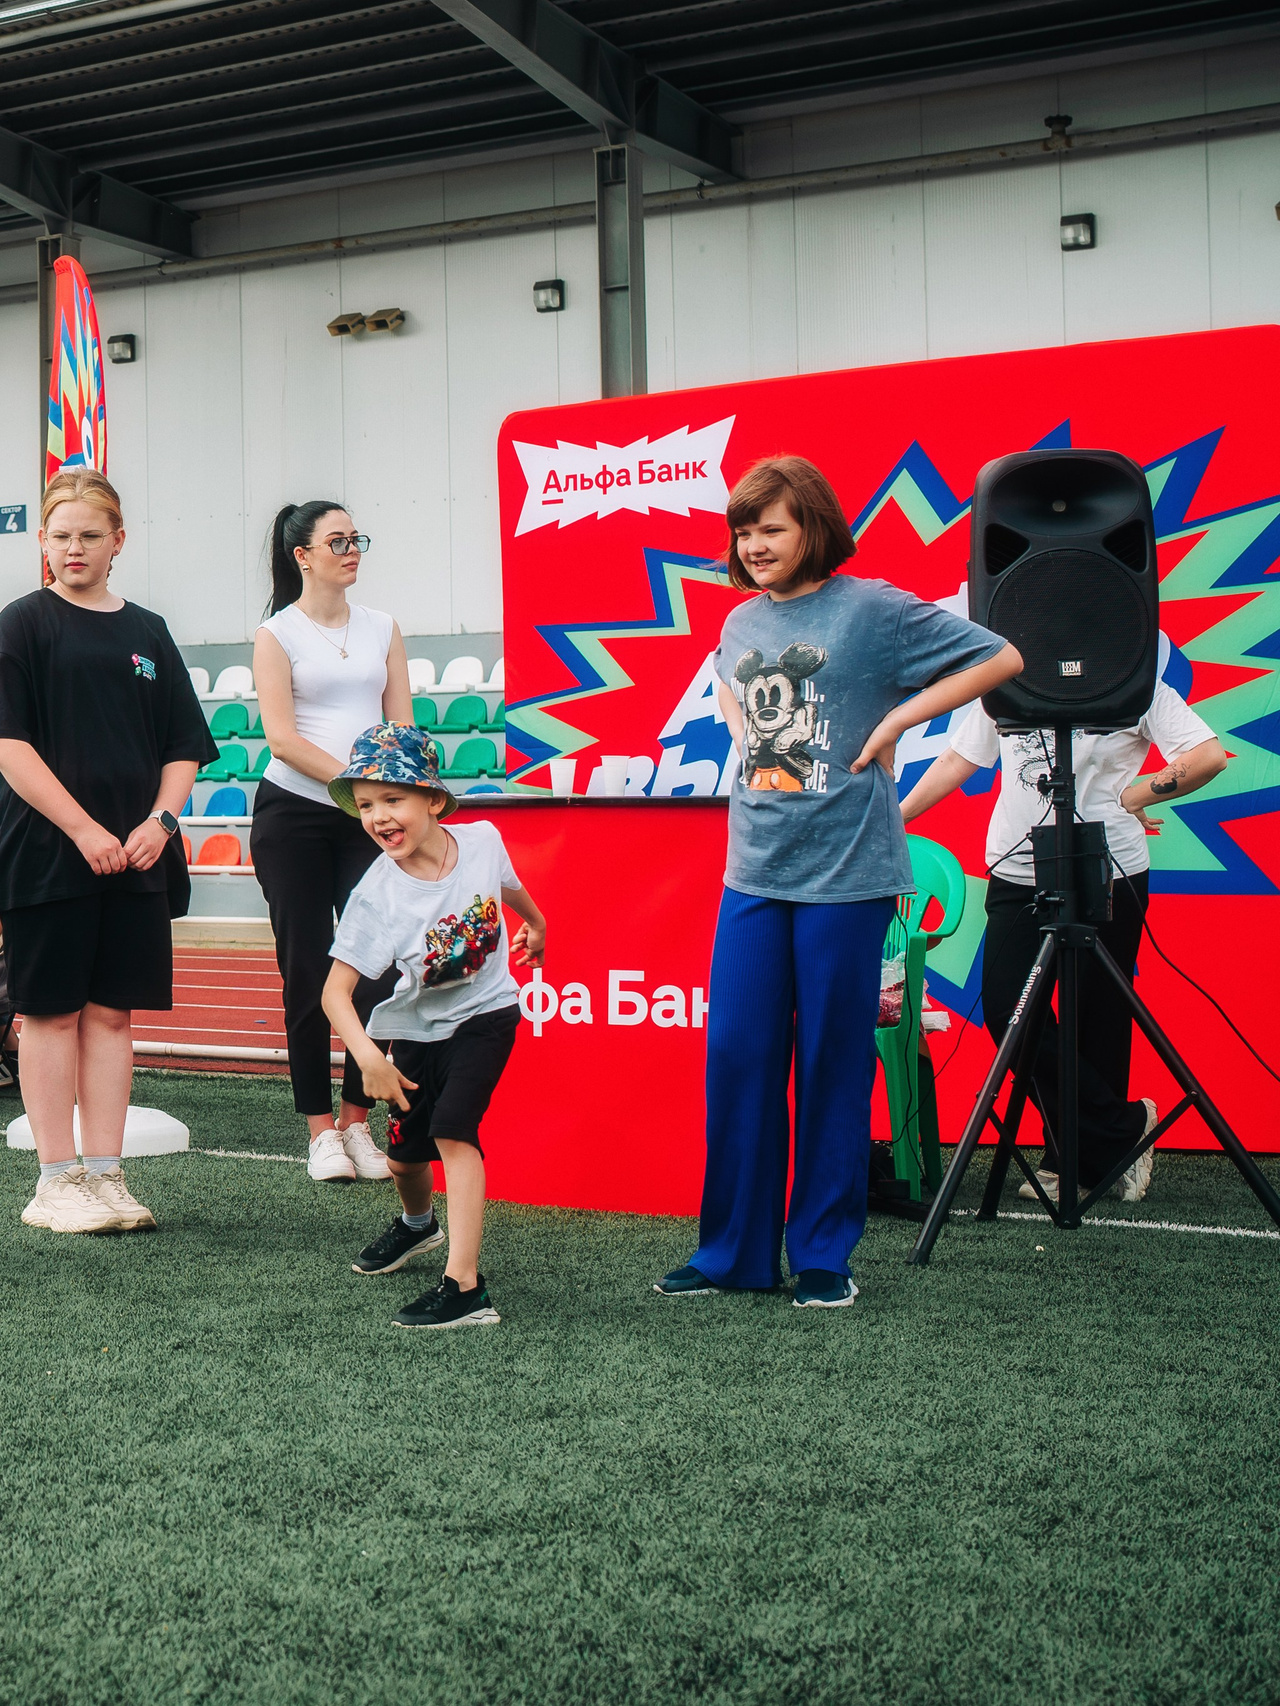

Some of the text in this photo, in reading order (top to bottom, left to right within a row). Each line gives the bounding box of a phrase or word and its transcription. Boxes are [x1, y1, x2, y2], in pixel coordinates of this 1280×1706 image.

[542, 459, 708, 496] Альфа Банк
[5, 513, 18, 532] 4
[608, 969, 709, 1028] Бан
[1008, 965, 1042, 1025] Soundking
